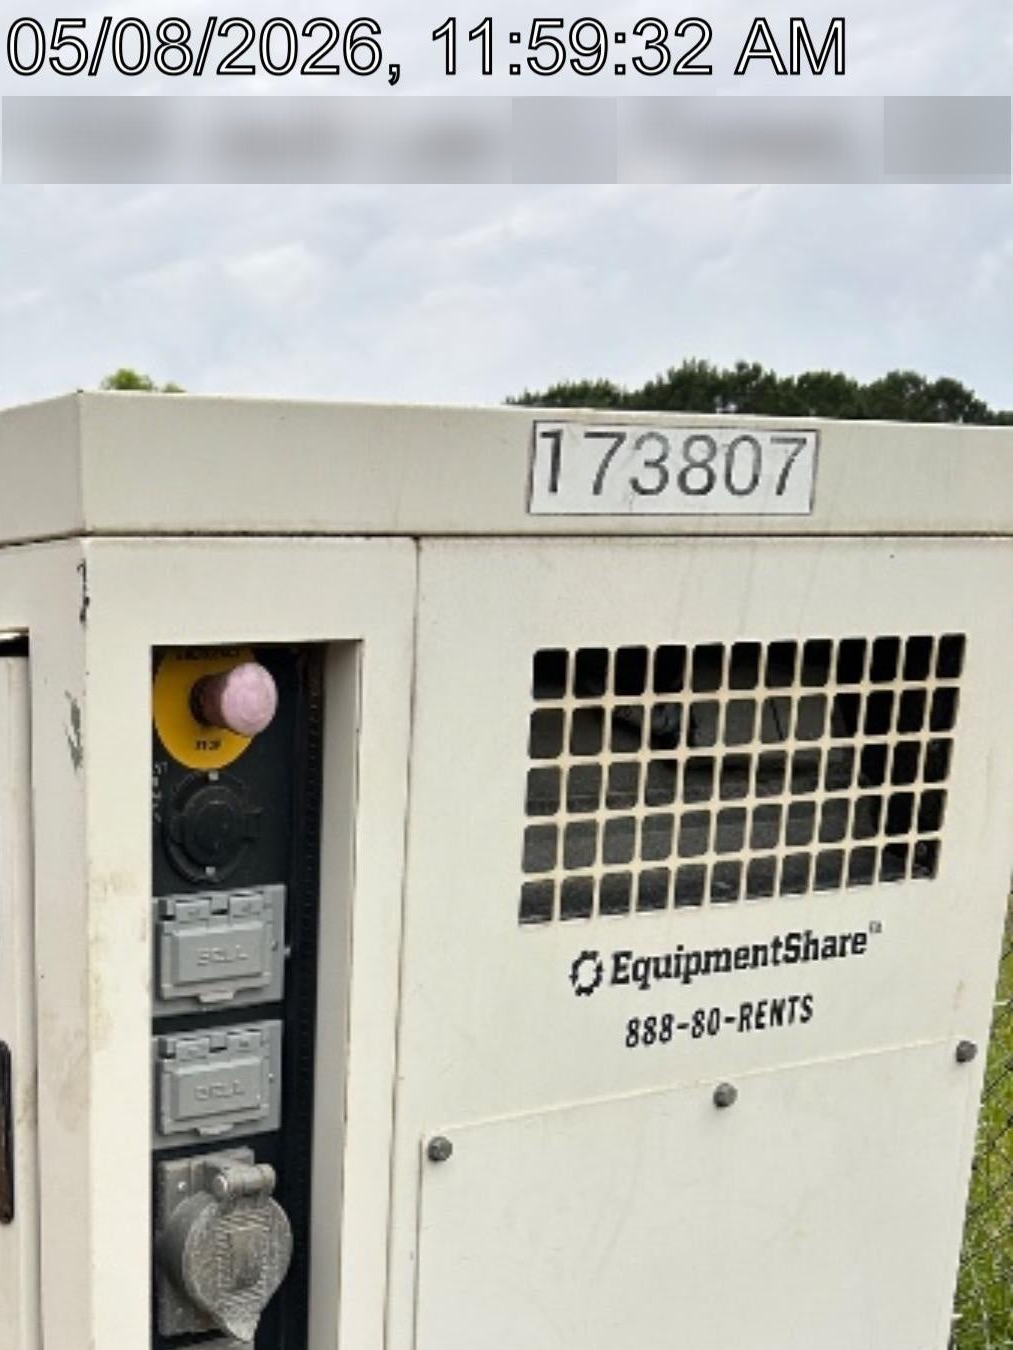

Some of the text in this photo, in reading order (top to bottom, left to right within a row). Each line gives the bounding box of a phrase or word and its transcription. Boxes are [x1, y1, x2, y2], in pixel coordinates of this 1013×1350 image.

[540, 428, 807, 496] 173807
[610, 929, 868, 990] EquipmentShare
[625, 994, 814, 1048] 888-80-RENTS
